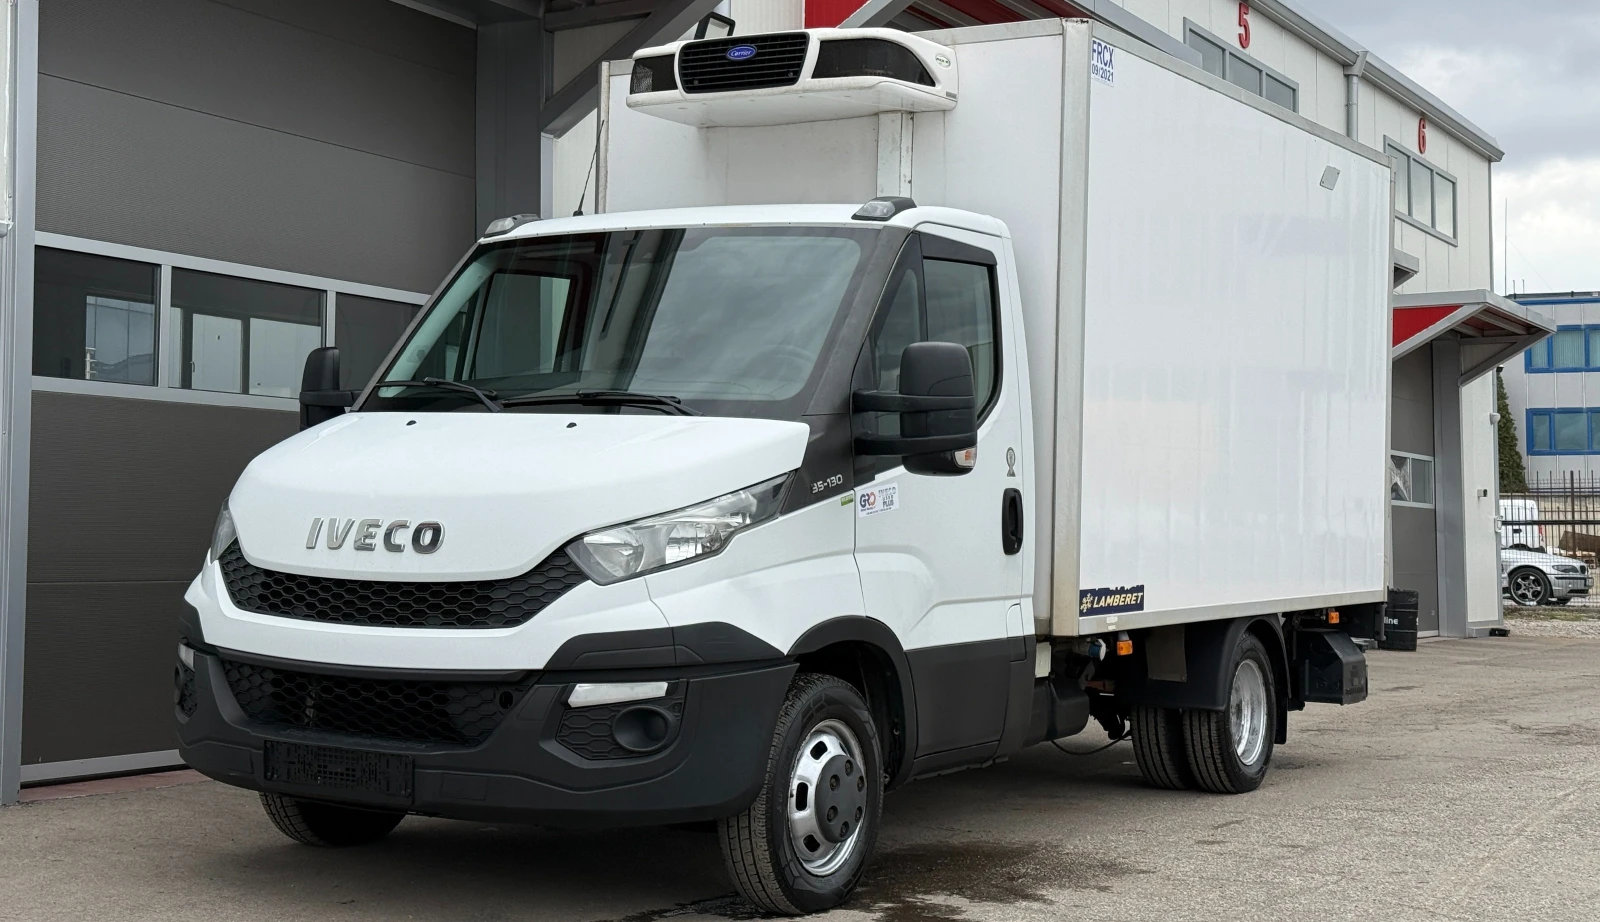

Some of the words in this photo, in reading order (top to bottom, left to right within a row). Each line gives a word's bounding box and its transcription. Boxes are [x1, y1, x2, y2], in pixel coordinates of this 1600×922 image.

[1238, 2, 1250, 49] 5
[1091, 39, 1114, 70] FRCX
[1091, 63, 1114, 83] 09/2021
[1418, 117, 1427, 155] 6
[811, 474, 843, 494] 35-130
[305, 517, 446, 555] IVECO
[1092, 592, 1144, 608] LAMBERET
